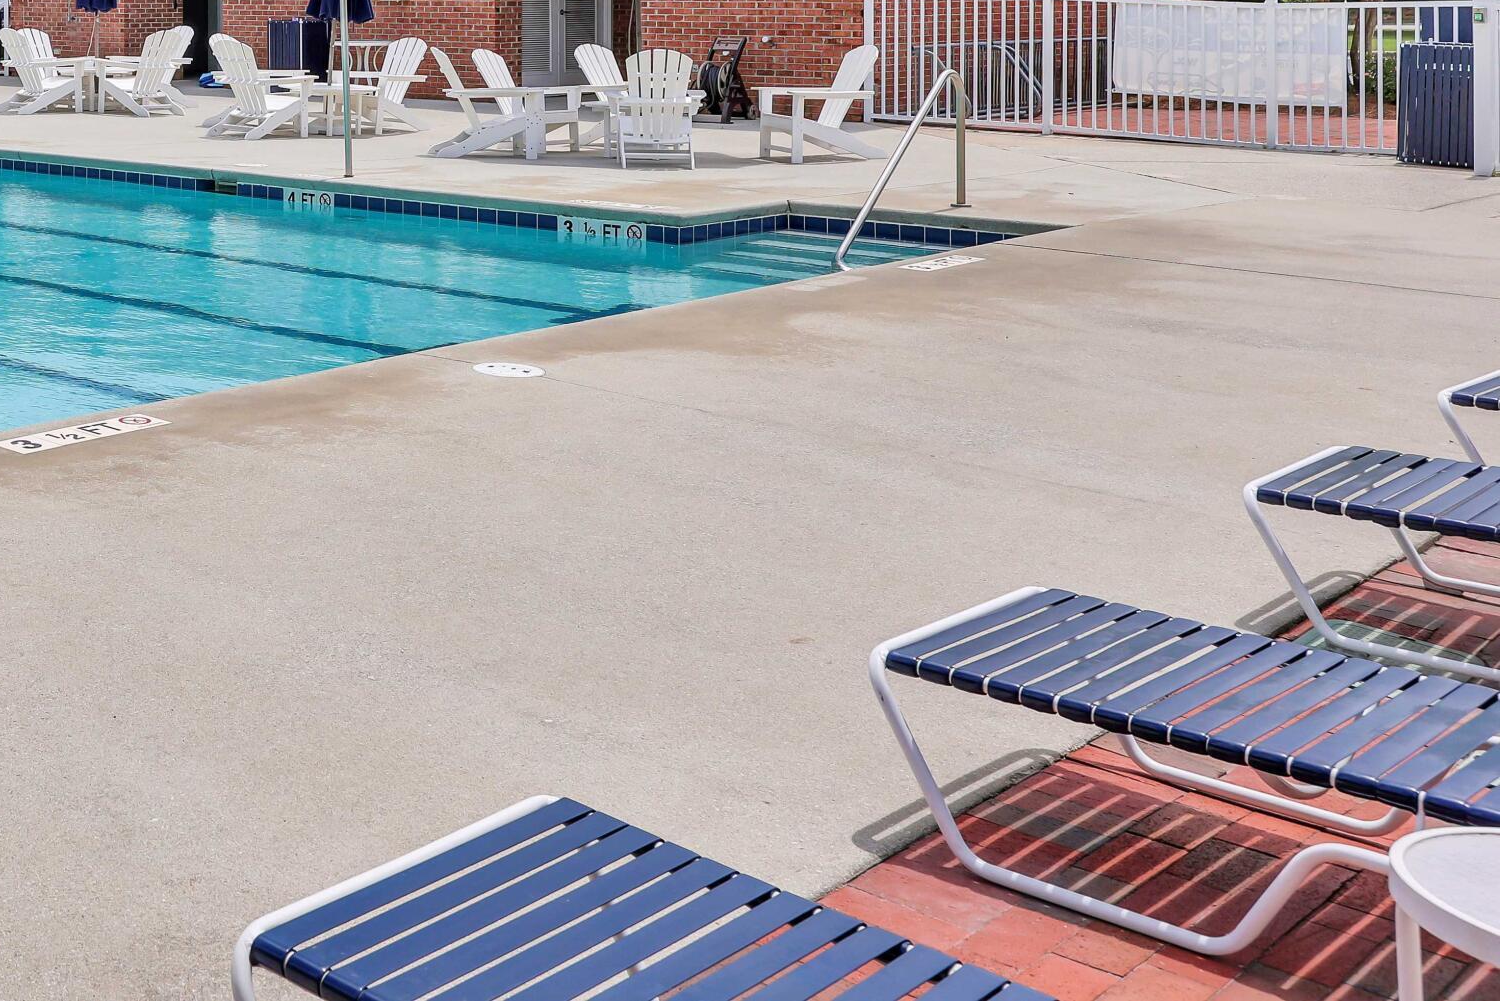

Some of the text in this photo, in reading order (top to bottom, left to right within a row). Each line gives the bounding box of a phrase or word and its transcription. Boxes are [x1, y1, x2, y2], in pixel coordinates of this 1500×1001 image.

[288, 191, 315, 205] 4 FT
[563, 220, 573, 232] 3
[603, 224, 621, 237] FT
[10, 439, 42, 449] 3
[77, 422, 122, 436] FT
